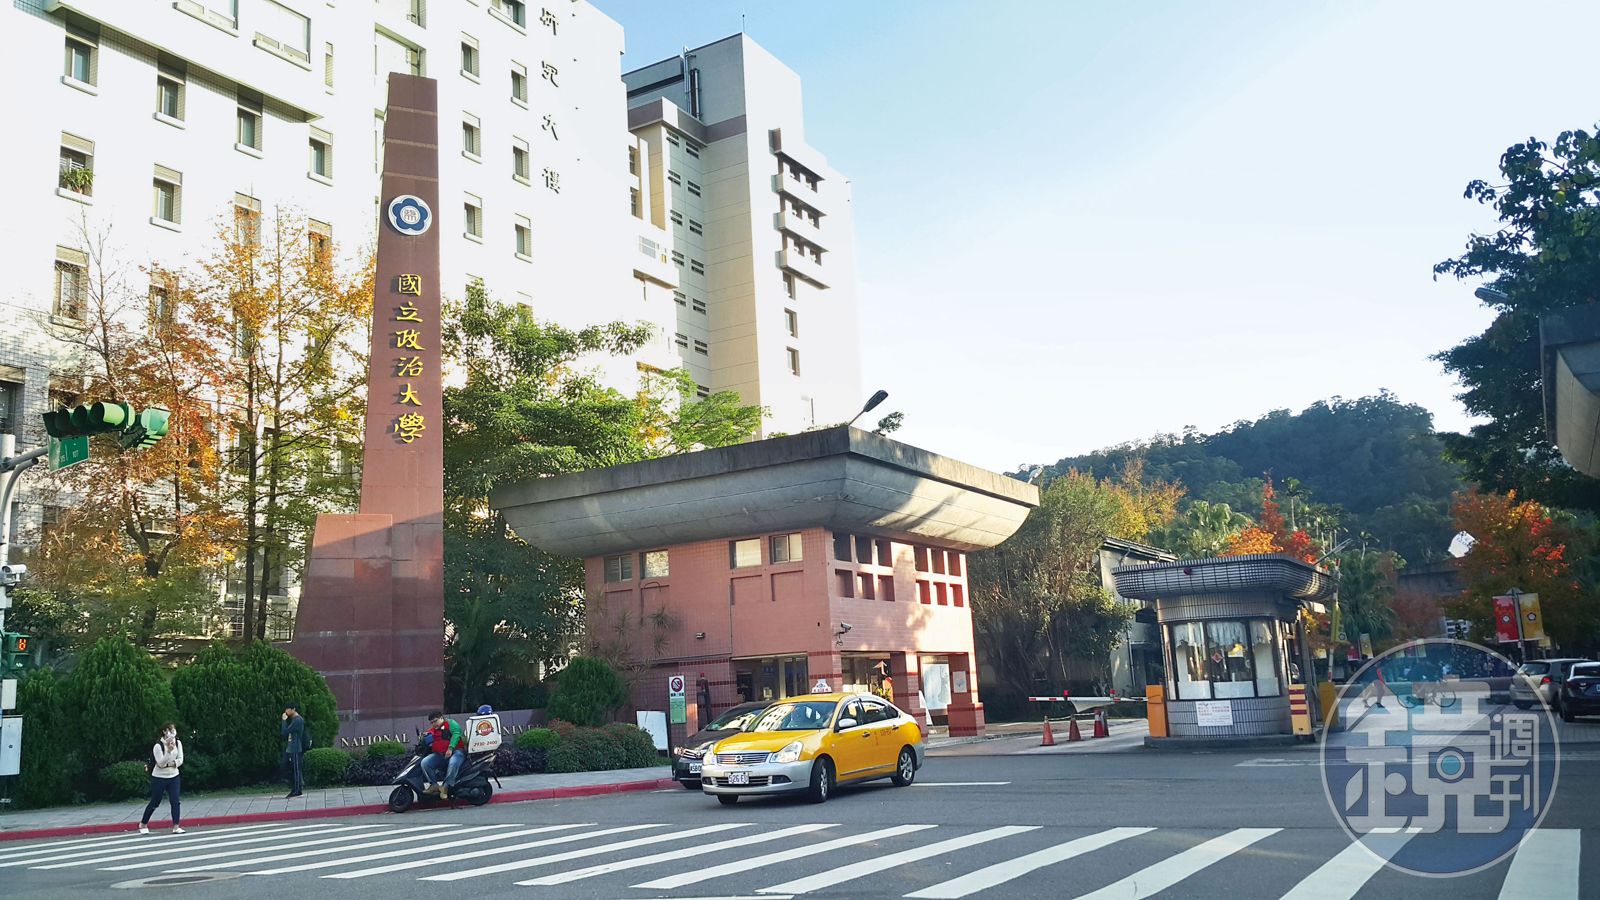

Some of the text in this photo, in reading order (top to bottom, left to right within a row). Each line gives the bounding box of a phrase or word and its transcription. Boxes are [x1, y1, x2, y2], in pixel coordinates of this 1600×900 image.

[395, 274, 426, 444] 國立政治大學
[341, 733, 410, 747] NATIONAL
